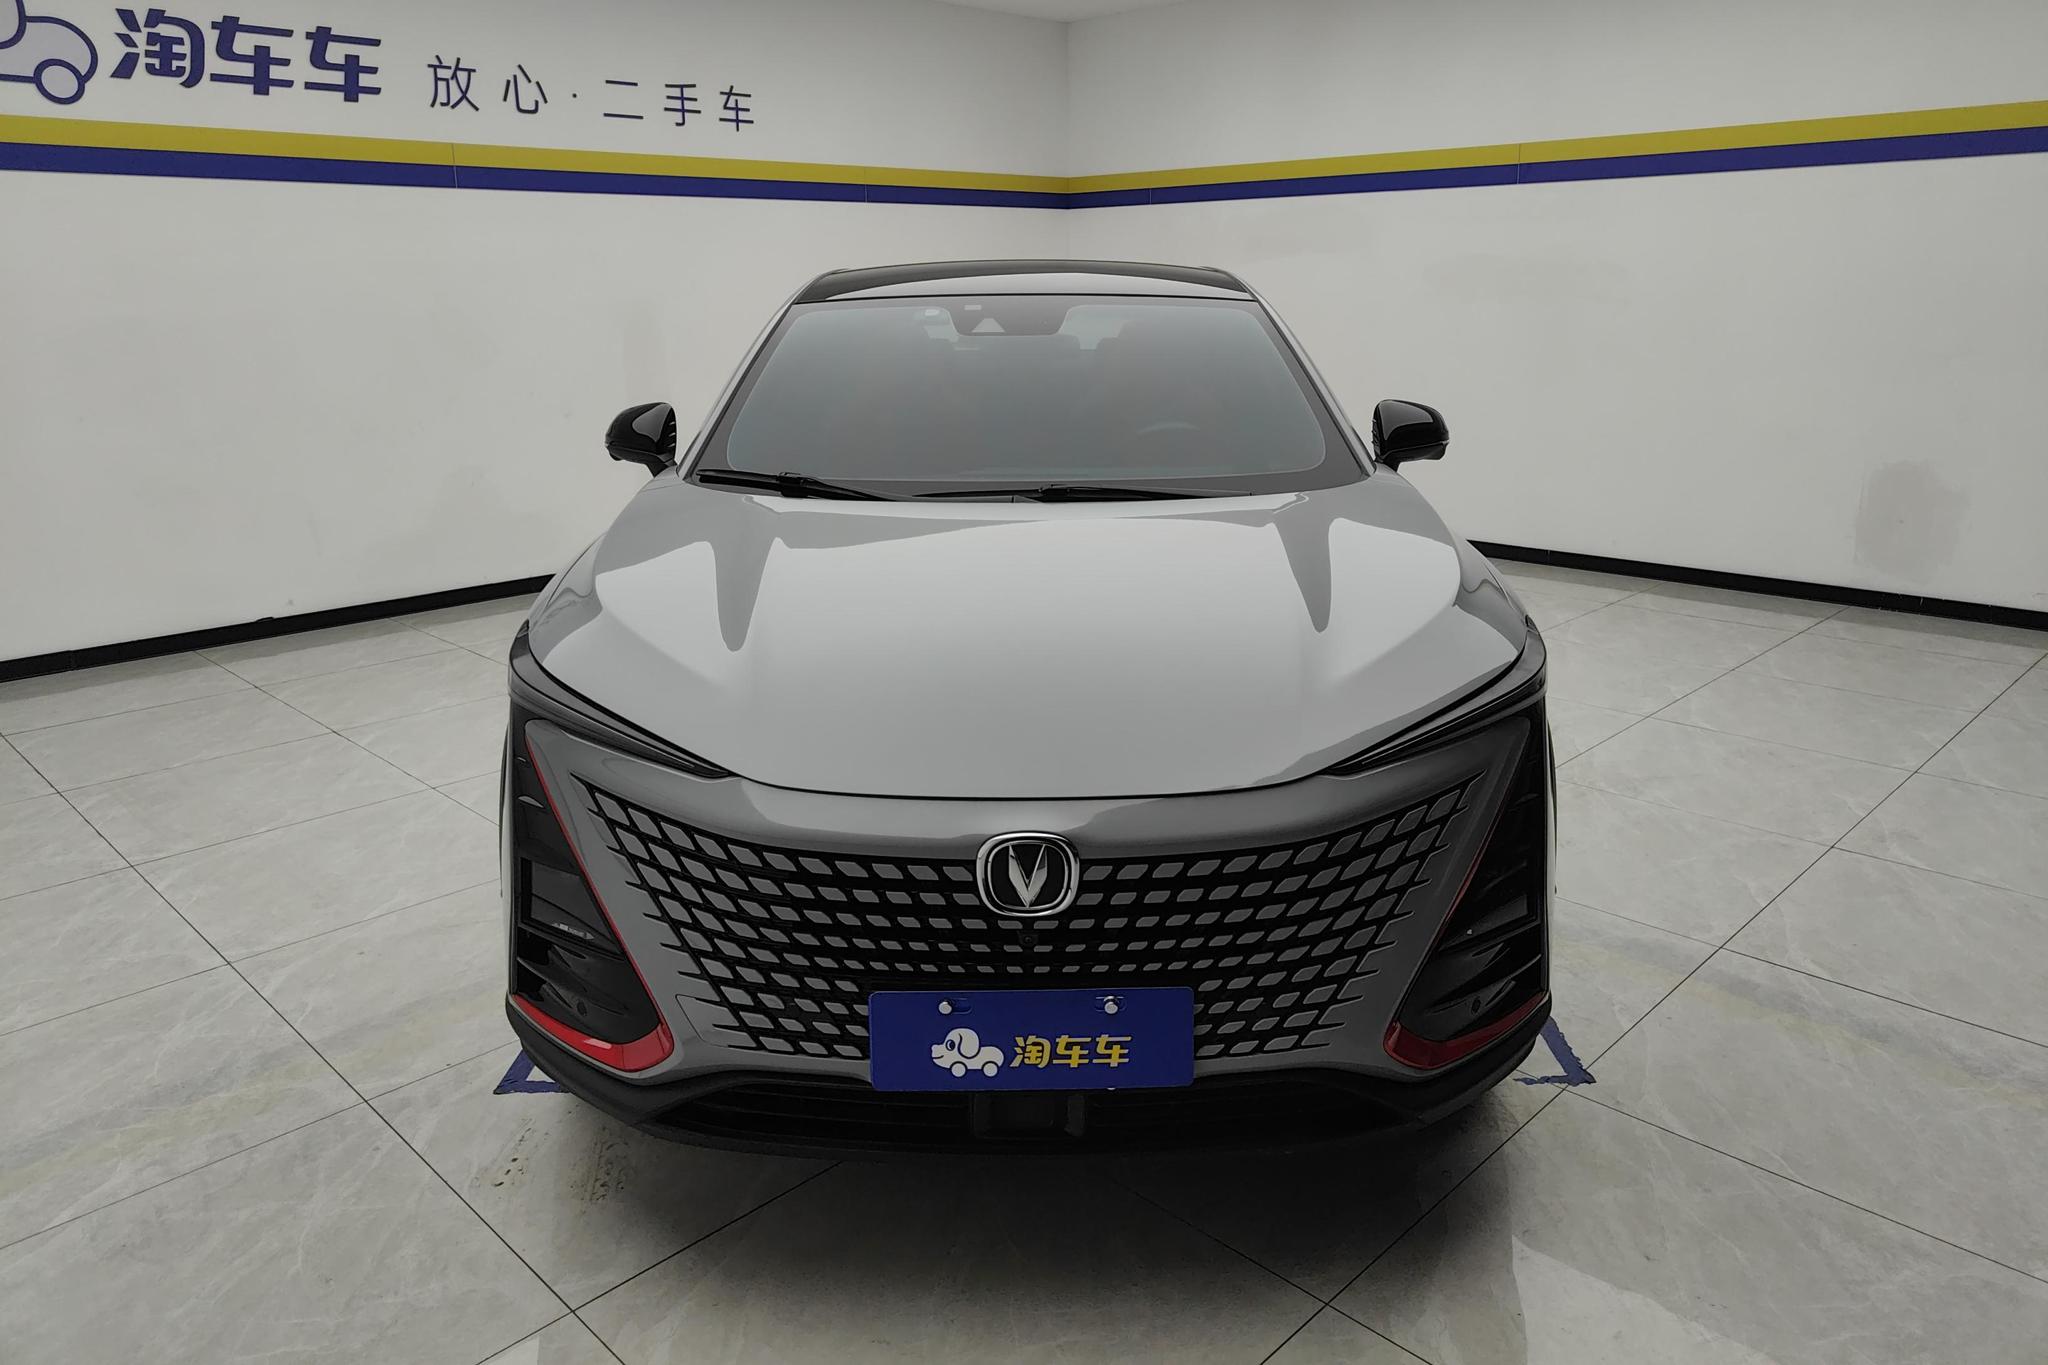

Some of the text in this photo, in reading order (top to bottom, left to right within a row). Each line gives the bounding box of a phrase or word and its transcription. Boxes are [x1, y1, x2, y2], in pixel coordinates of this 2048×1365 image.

[109, 8, 383, 103] 淘车车
[1009, 1034, 1132, 1069] 淘车车
